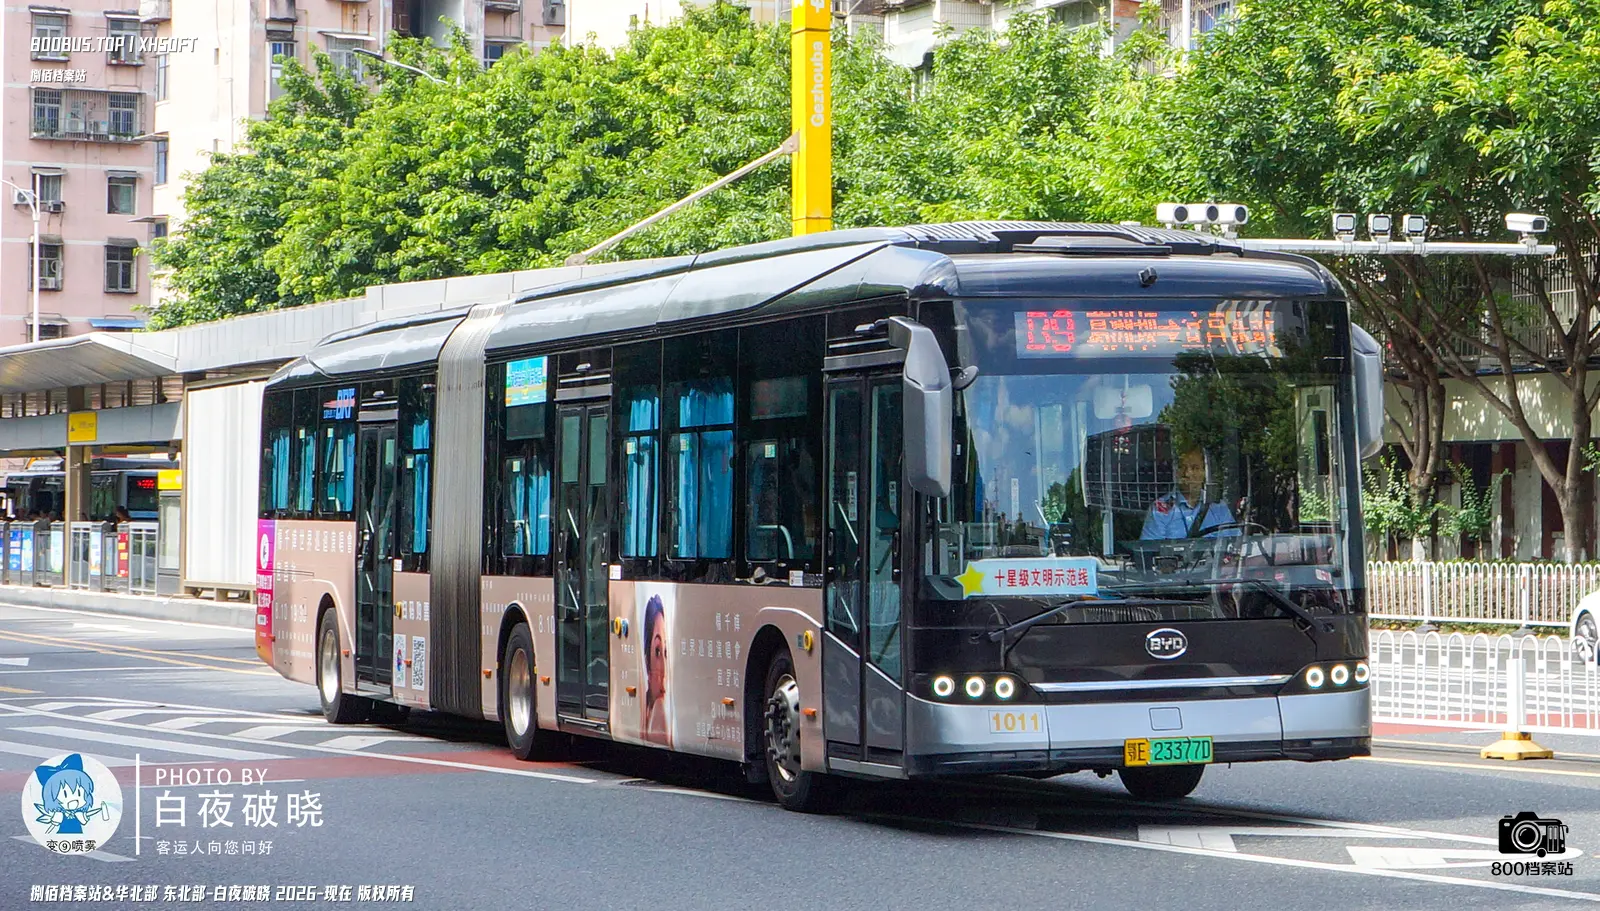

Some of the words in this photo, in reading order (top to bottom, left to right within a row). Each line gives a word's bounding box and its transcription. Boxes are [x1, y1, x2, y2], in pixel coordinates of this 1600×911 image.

[810, 41, 825, 127] Gezhouba
[994, 568, 1089, 587] 十星级文明示范线
[1150, 637, 1183, 651] BYD
[992, 712, 1039, 731] 1011
[1154, 740, 1211, 761] 23377D
